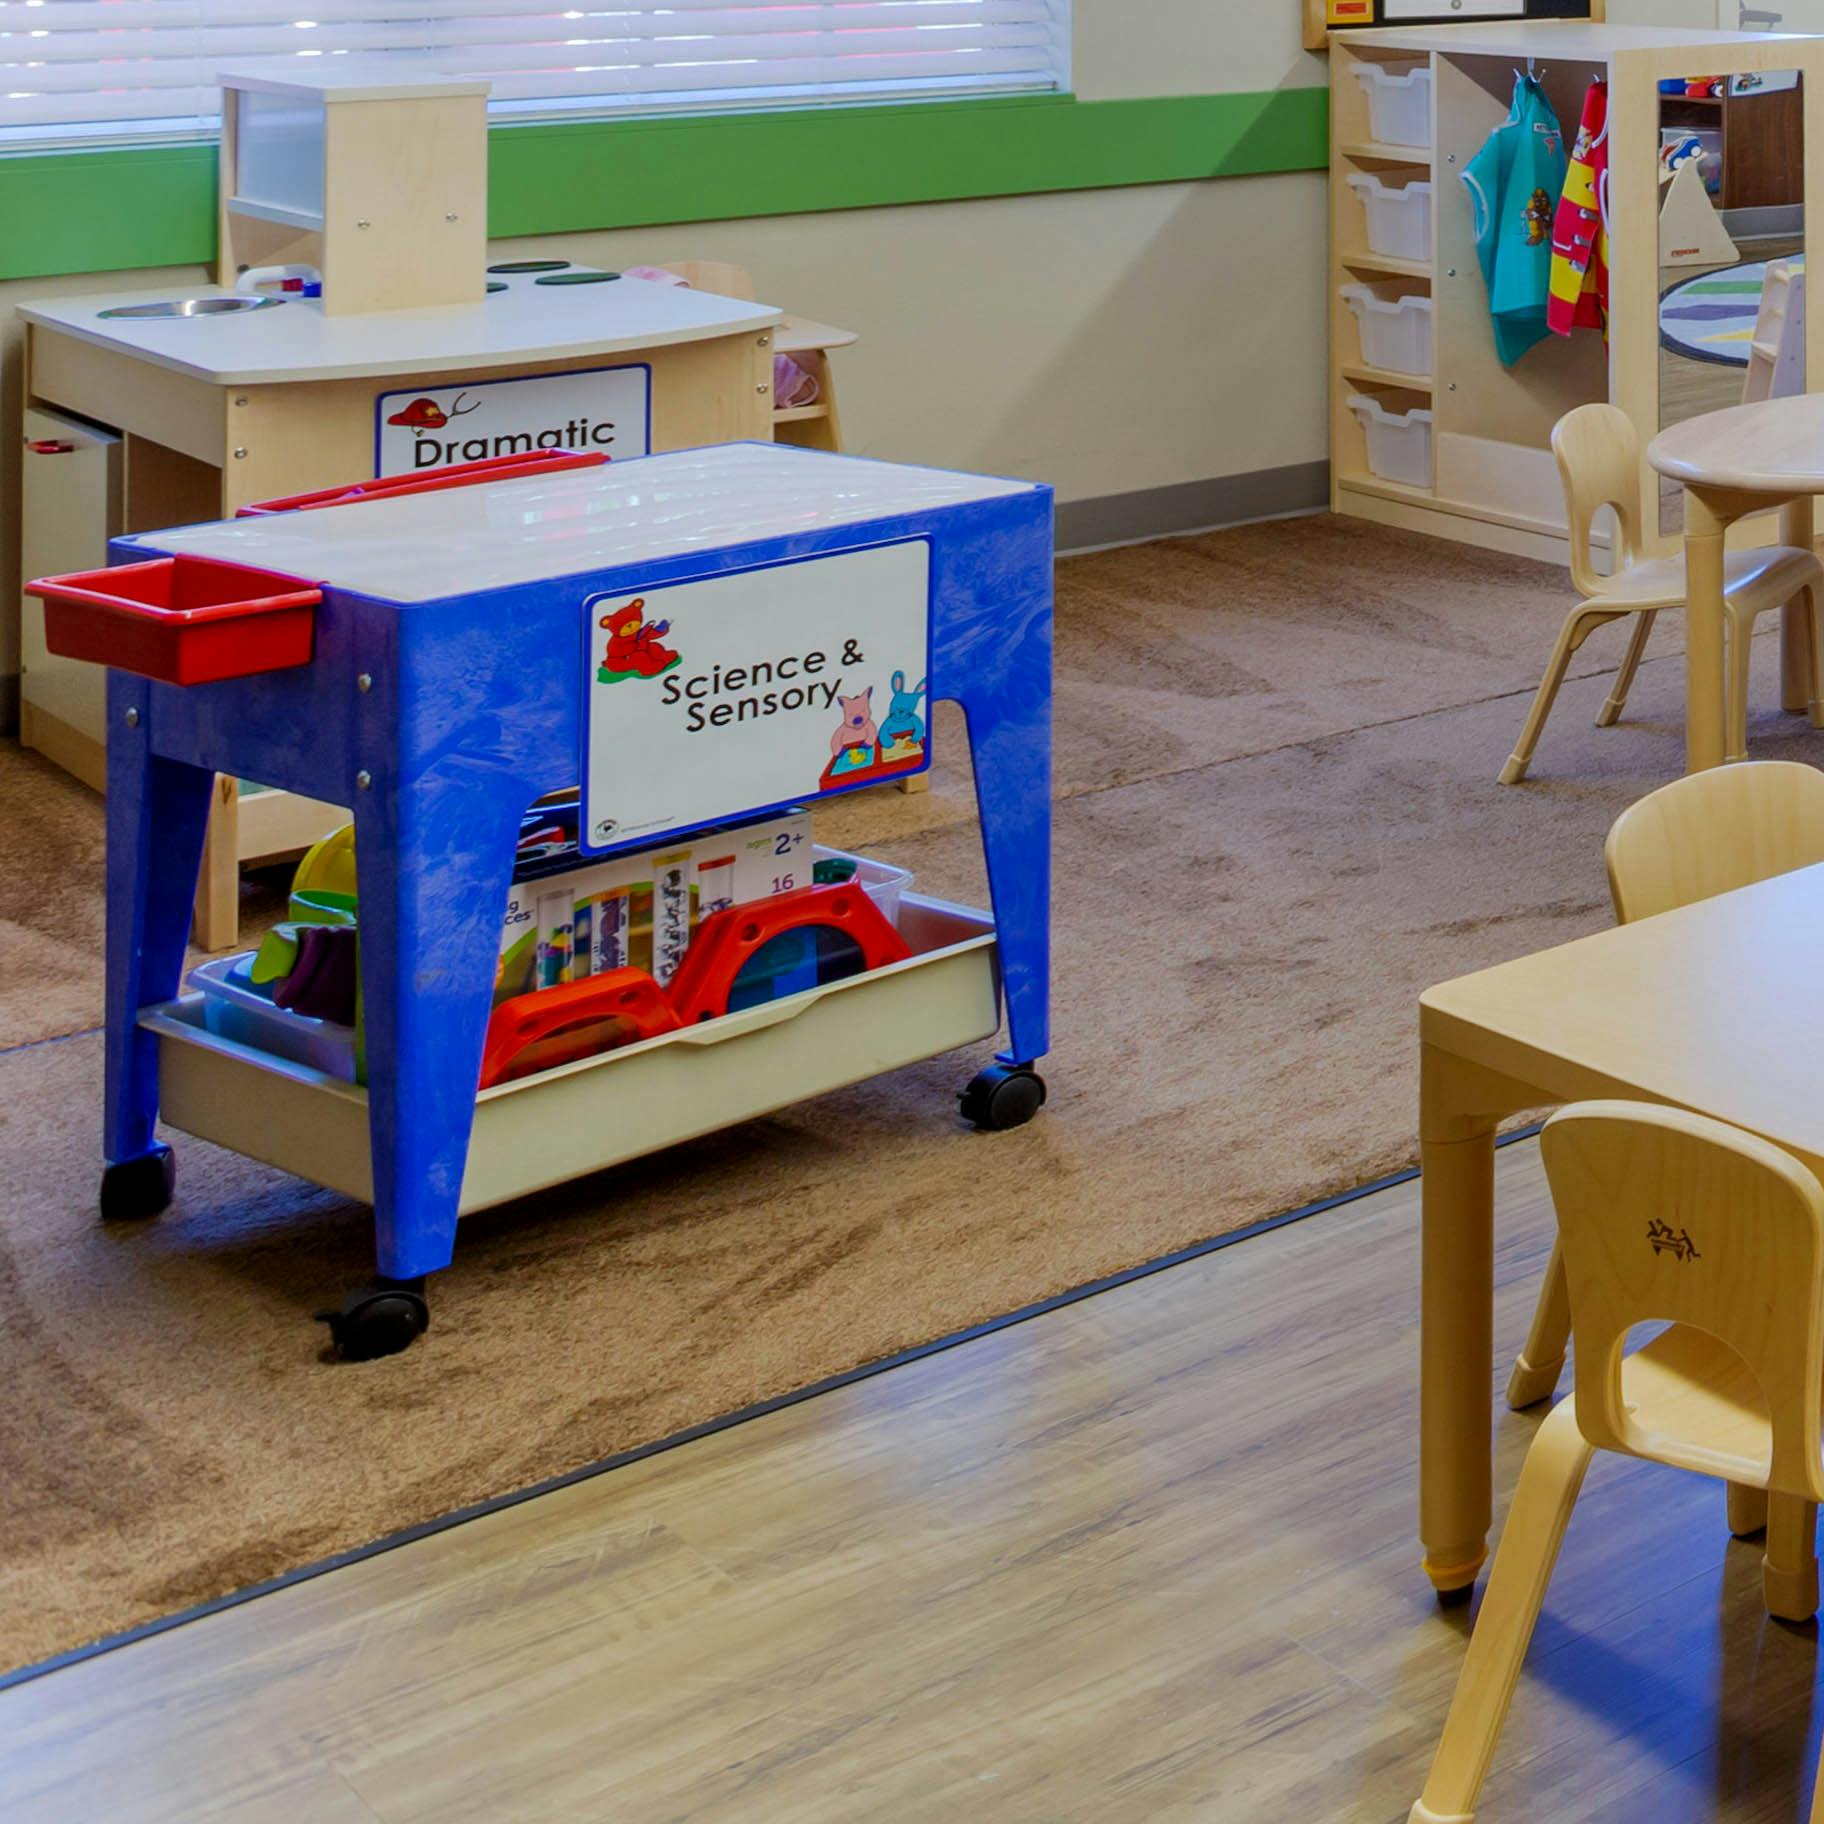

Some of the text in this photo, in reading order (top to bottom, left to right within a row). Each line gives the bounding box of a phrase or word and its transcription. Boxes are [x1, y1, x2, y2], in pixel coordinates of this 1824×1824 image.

[413, 418, 616, 470] Dramatic
[661, 636, 865, 706] Science &
[685, 678, 844, 735] Sensory
[774, 832, 804, 856] 2+
[771, 873, 794, 894] 16
